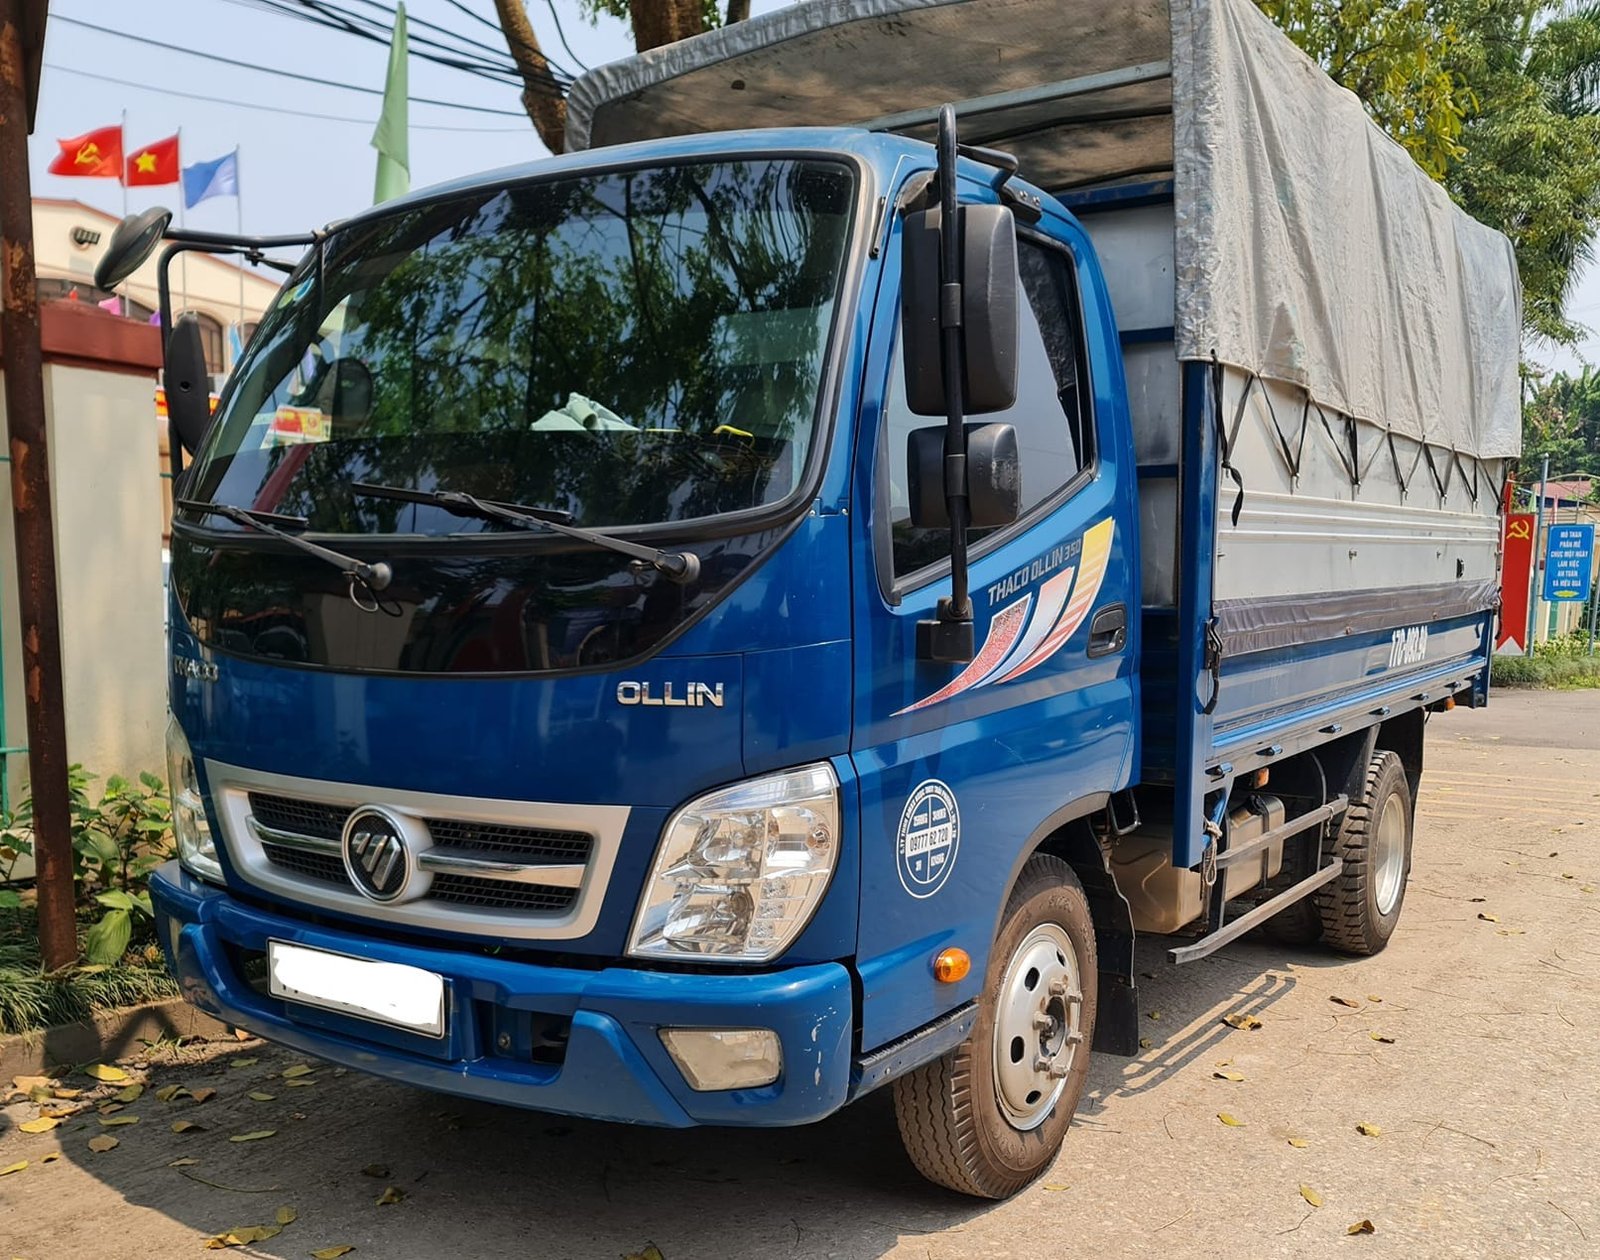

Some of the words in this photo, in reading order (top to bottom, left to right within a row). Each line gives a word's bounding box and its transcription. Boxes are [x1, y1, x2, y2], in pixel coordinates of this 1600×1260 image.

[988, 567, 1030, 607] THACO
[1030, 546, 1064, 580] OLLIN
[1064, 539, 1082, 561] 350
[616, 681, 724, 706] OLLIN
